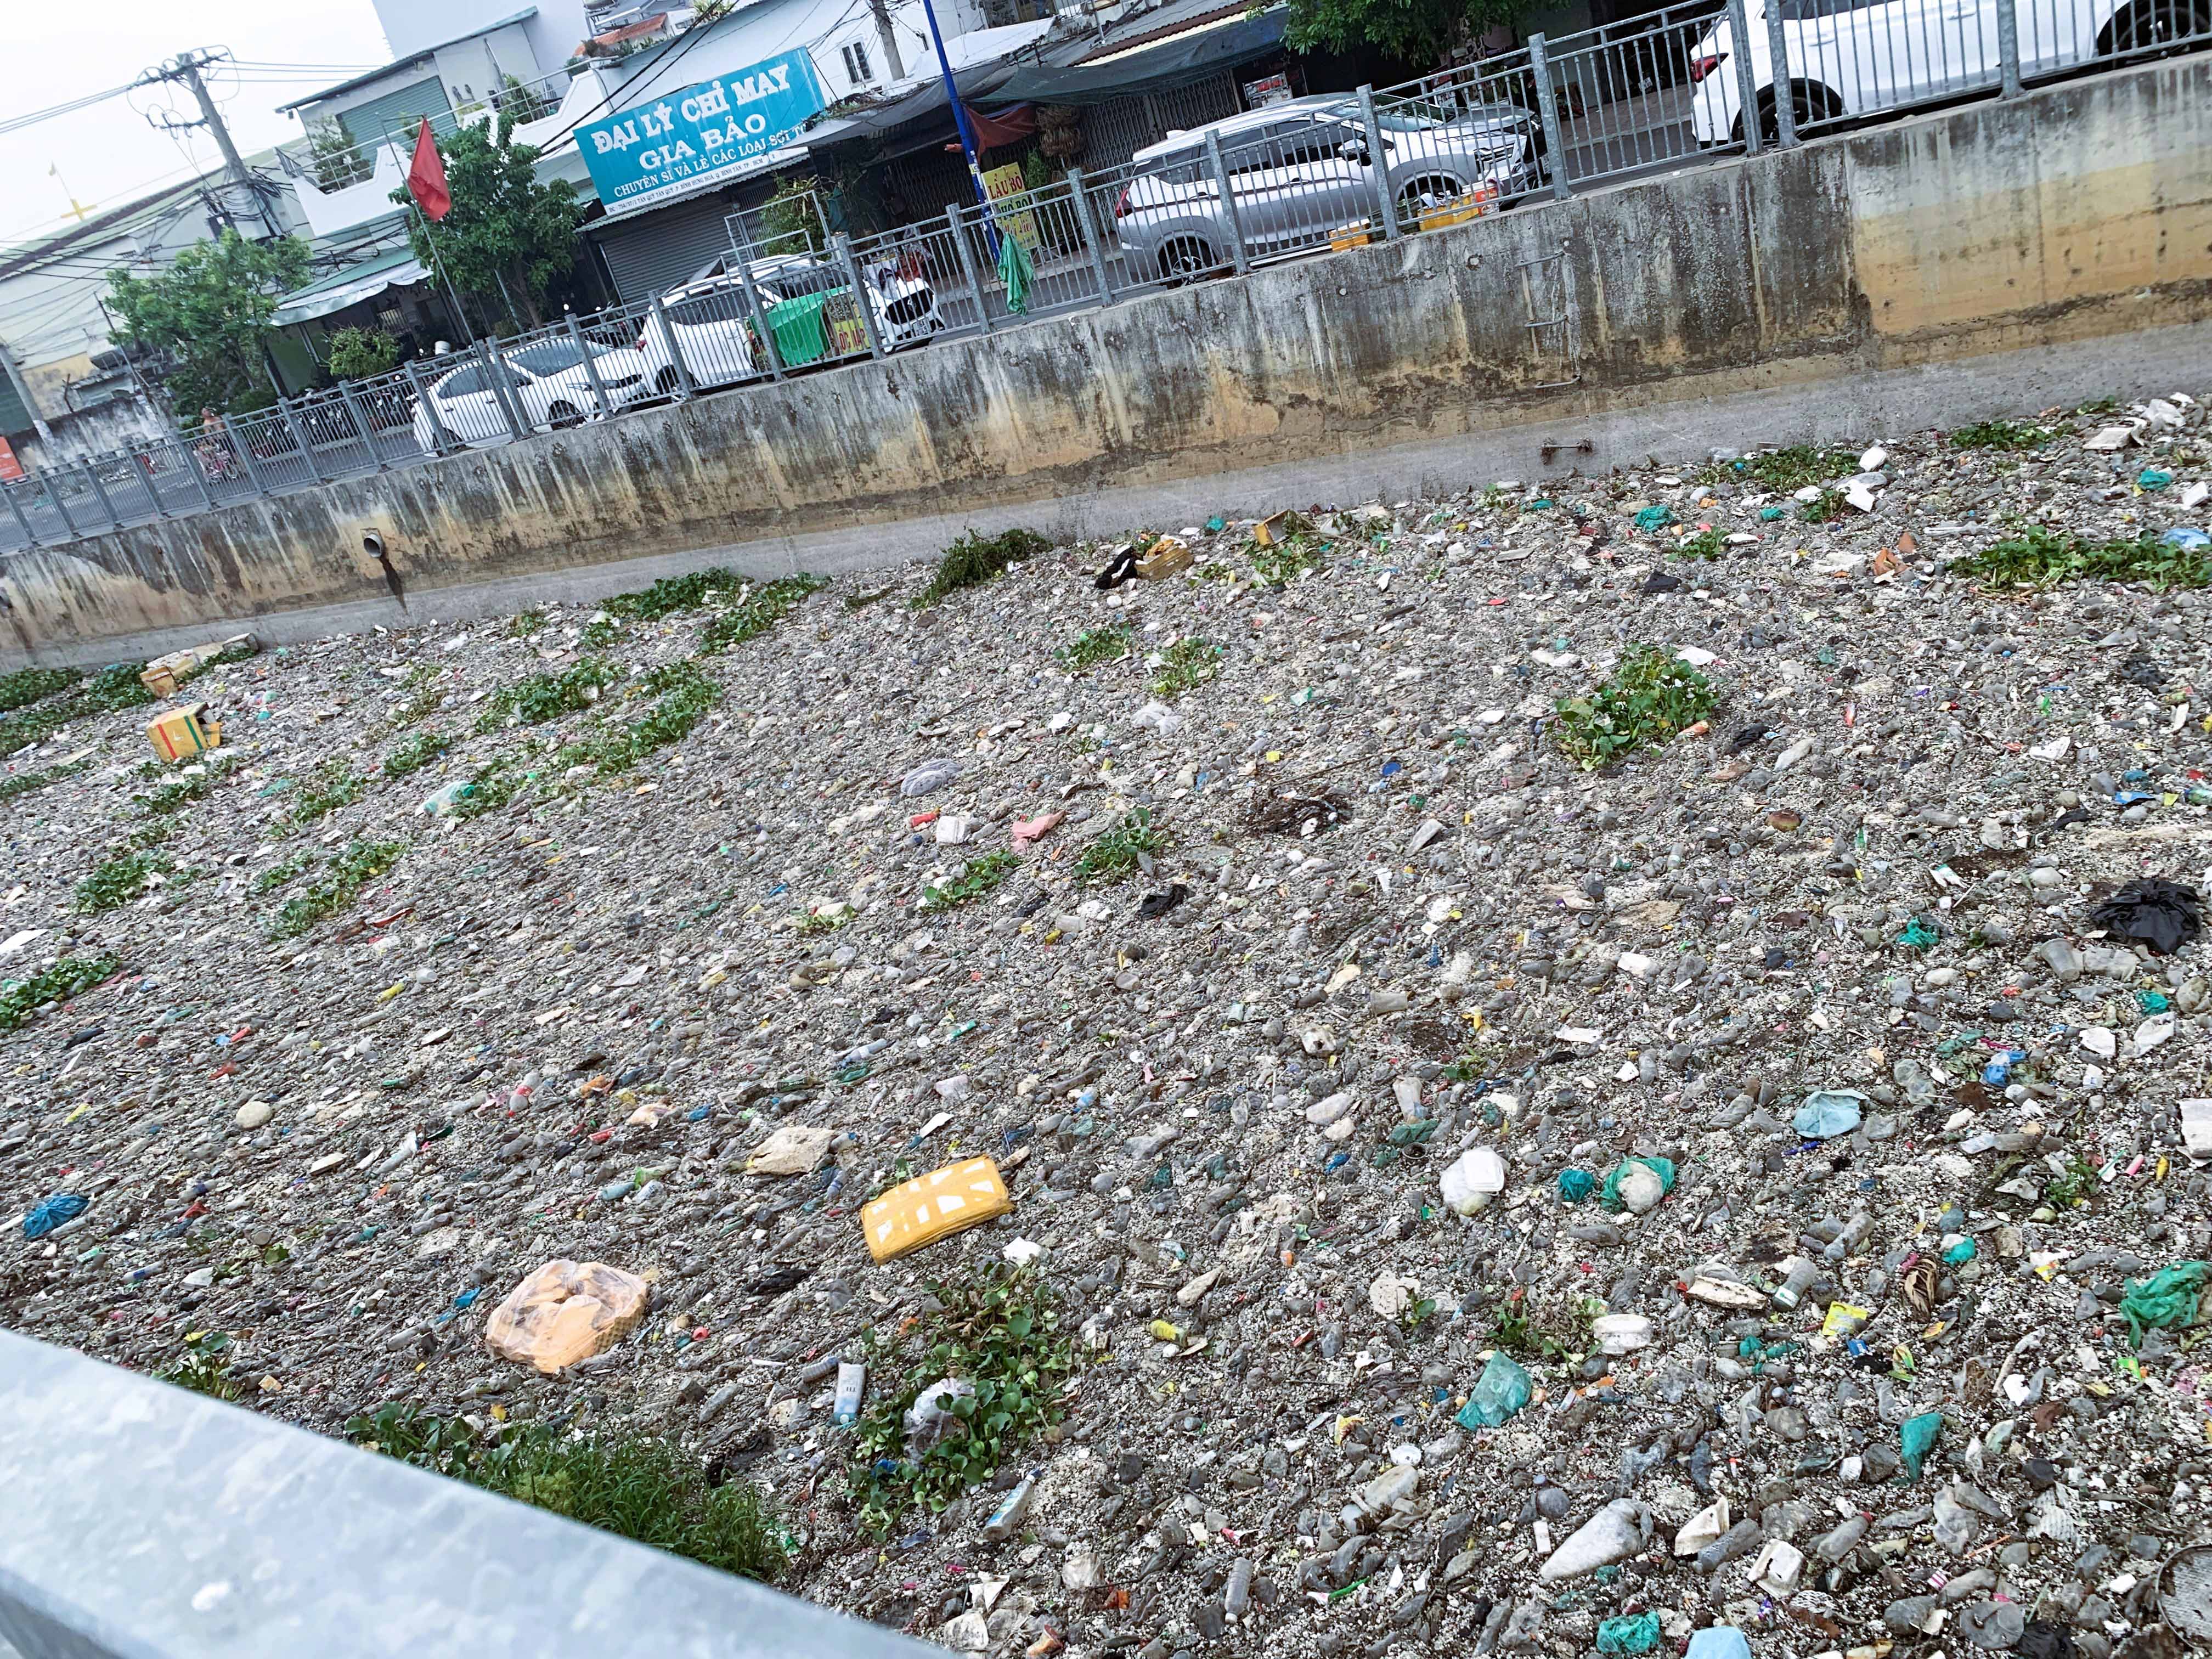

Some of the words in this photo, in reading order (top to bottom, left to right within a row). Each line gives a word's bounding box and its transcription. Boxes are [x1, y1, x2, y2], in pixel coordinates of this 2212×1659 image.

[591, 120, 640, 154] ĐẠI
[641, 103, 674, 137] LÝ
[681, 80, 730, 122] CHỈ
[731, 63, 790, 105] MAY
[614, 174, 659, 197] CHUYÊN
[674, 162, 692, 177] VÀ
[693, 154, 709, 171] LẺ
[712, 149, 736, 165] CÁC
[737, 138, 766, 156] LOẠI
[639, 140, 696, 169] GIA
[701, 114, 766, 149] BẢO
[1009, 172, 1023, 192] BÒ
